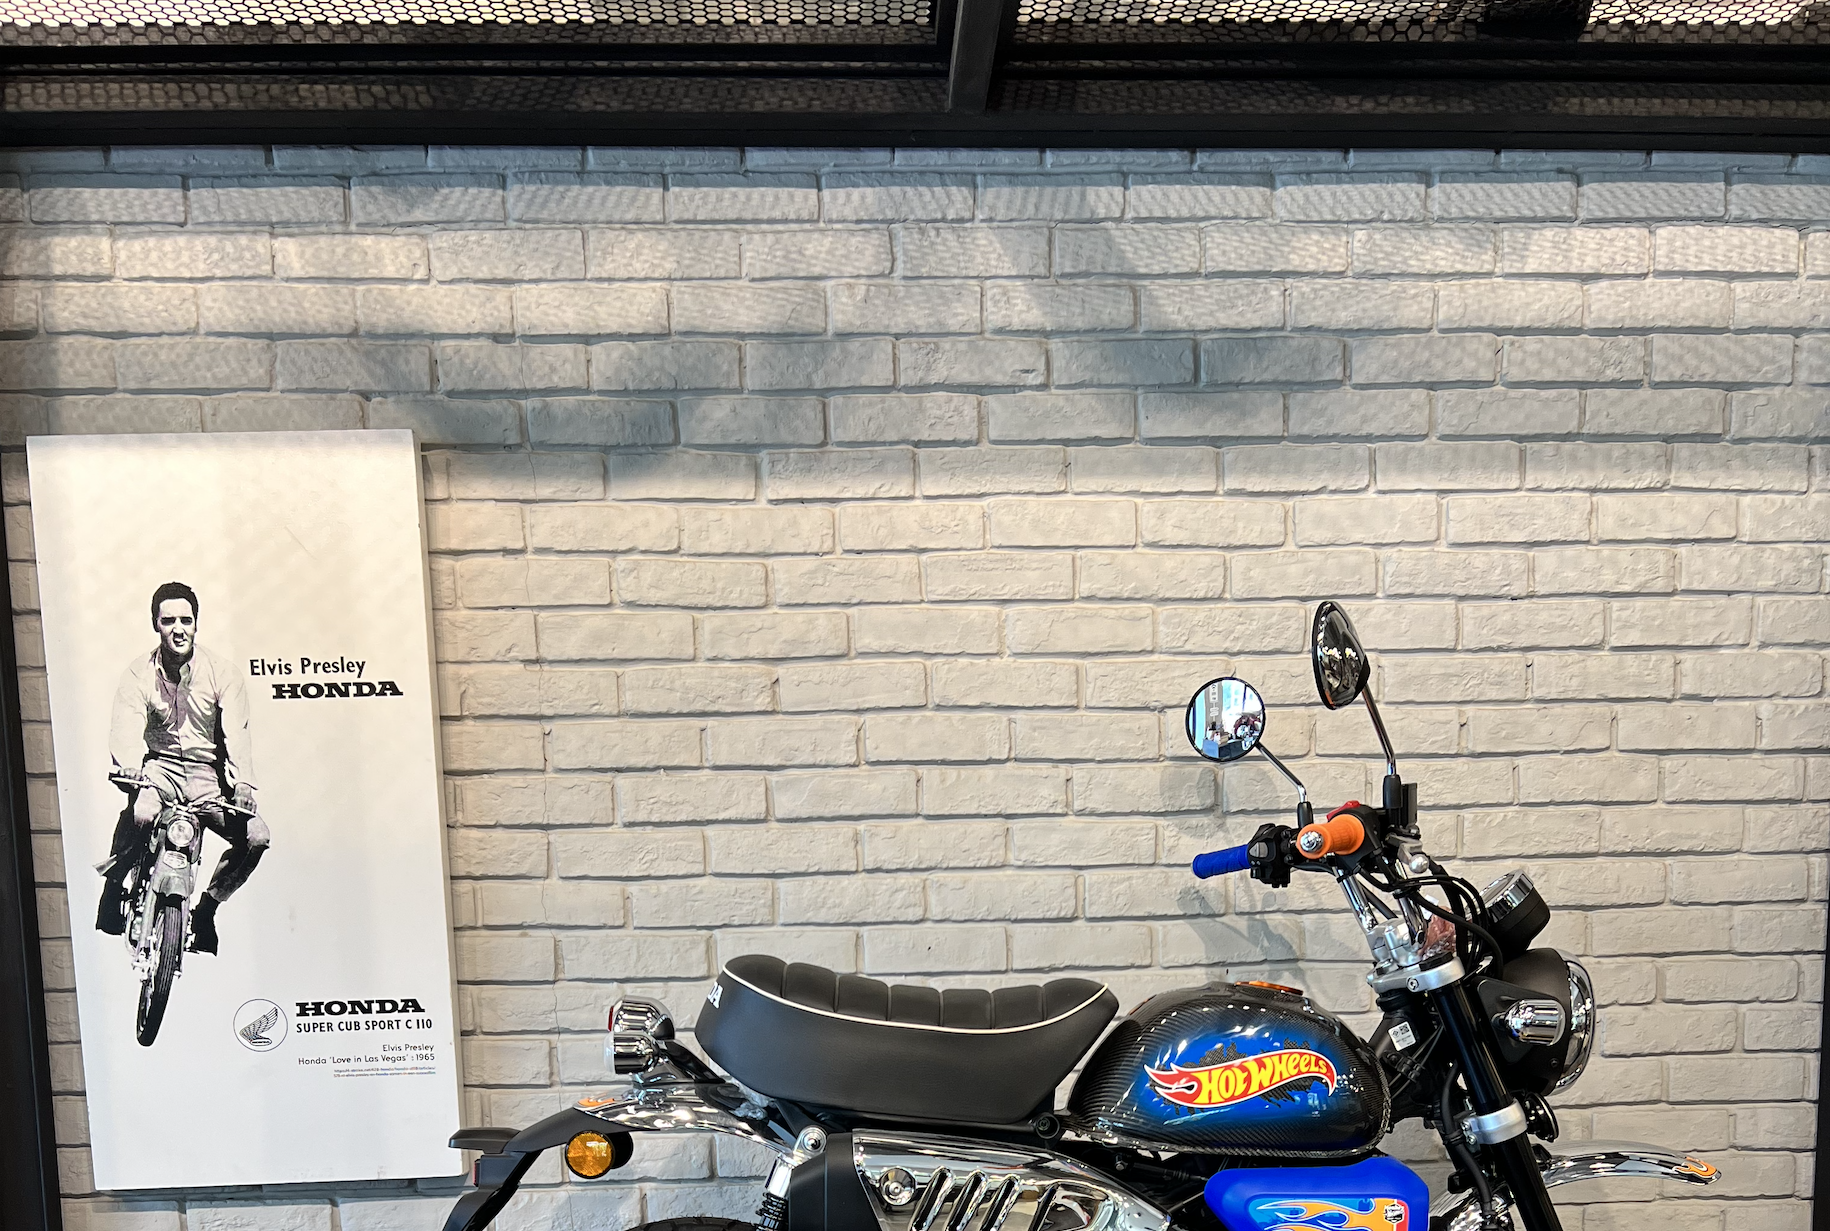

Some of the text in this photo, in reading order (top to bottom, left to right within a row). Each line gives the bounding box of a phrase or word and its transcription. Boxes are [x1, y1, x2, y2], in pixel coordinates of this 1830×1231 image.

[249, 656, 366, 679] Elvis Presley
[272, 681, 403, 699] HONDA
[295, 998, 425, 1017] HONDA
[296, 1018, 433, 1033] SUPER CUB SPORT C 110
[382, 1043, 434, 1052] Elvis Presley
[298, 1057, 327, 1065] Honda
[353, 1055, 362, 1063] in
[415, 1053, 435, 1061] 1965
